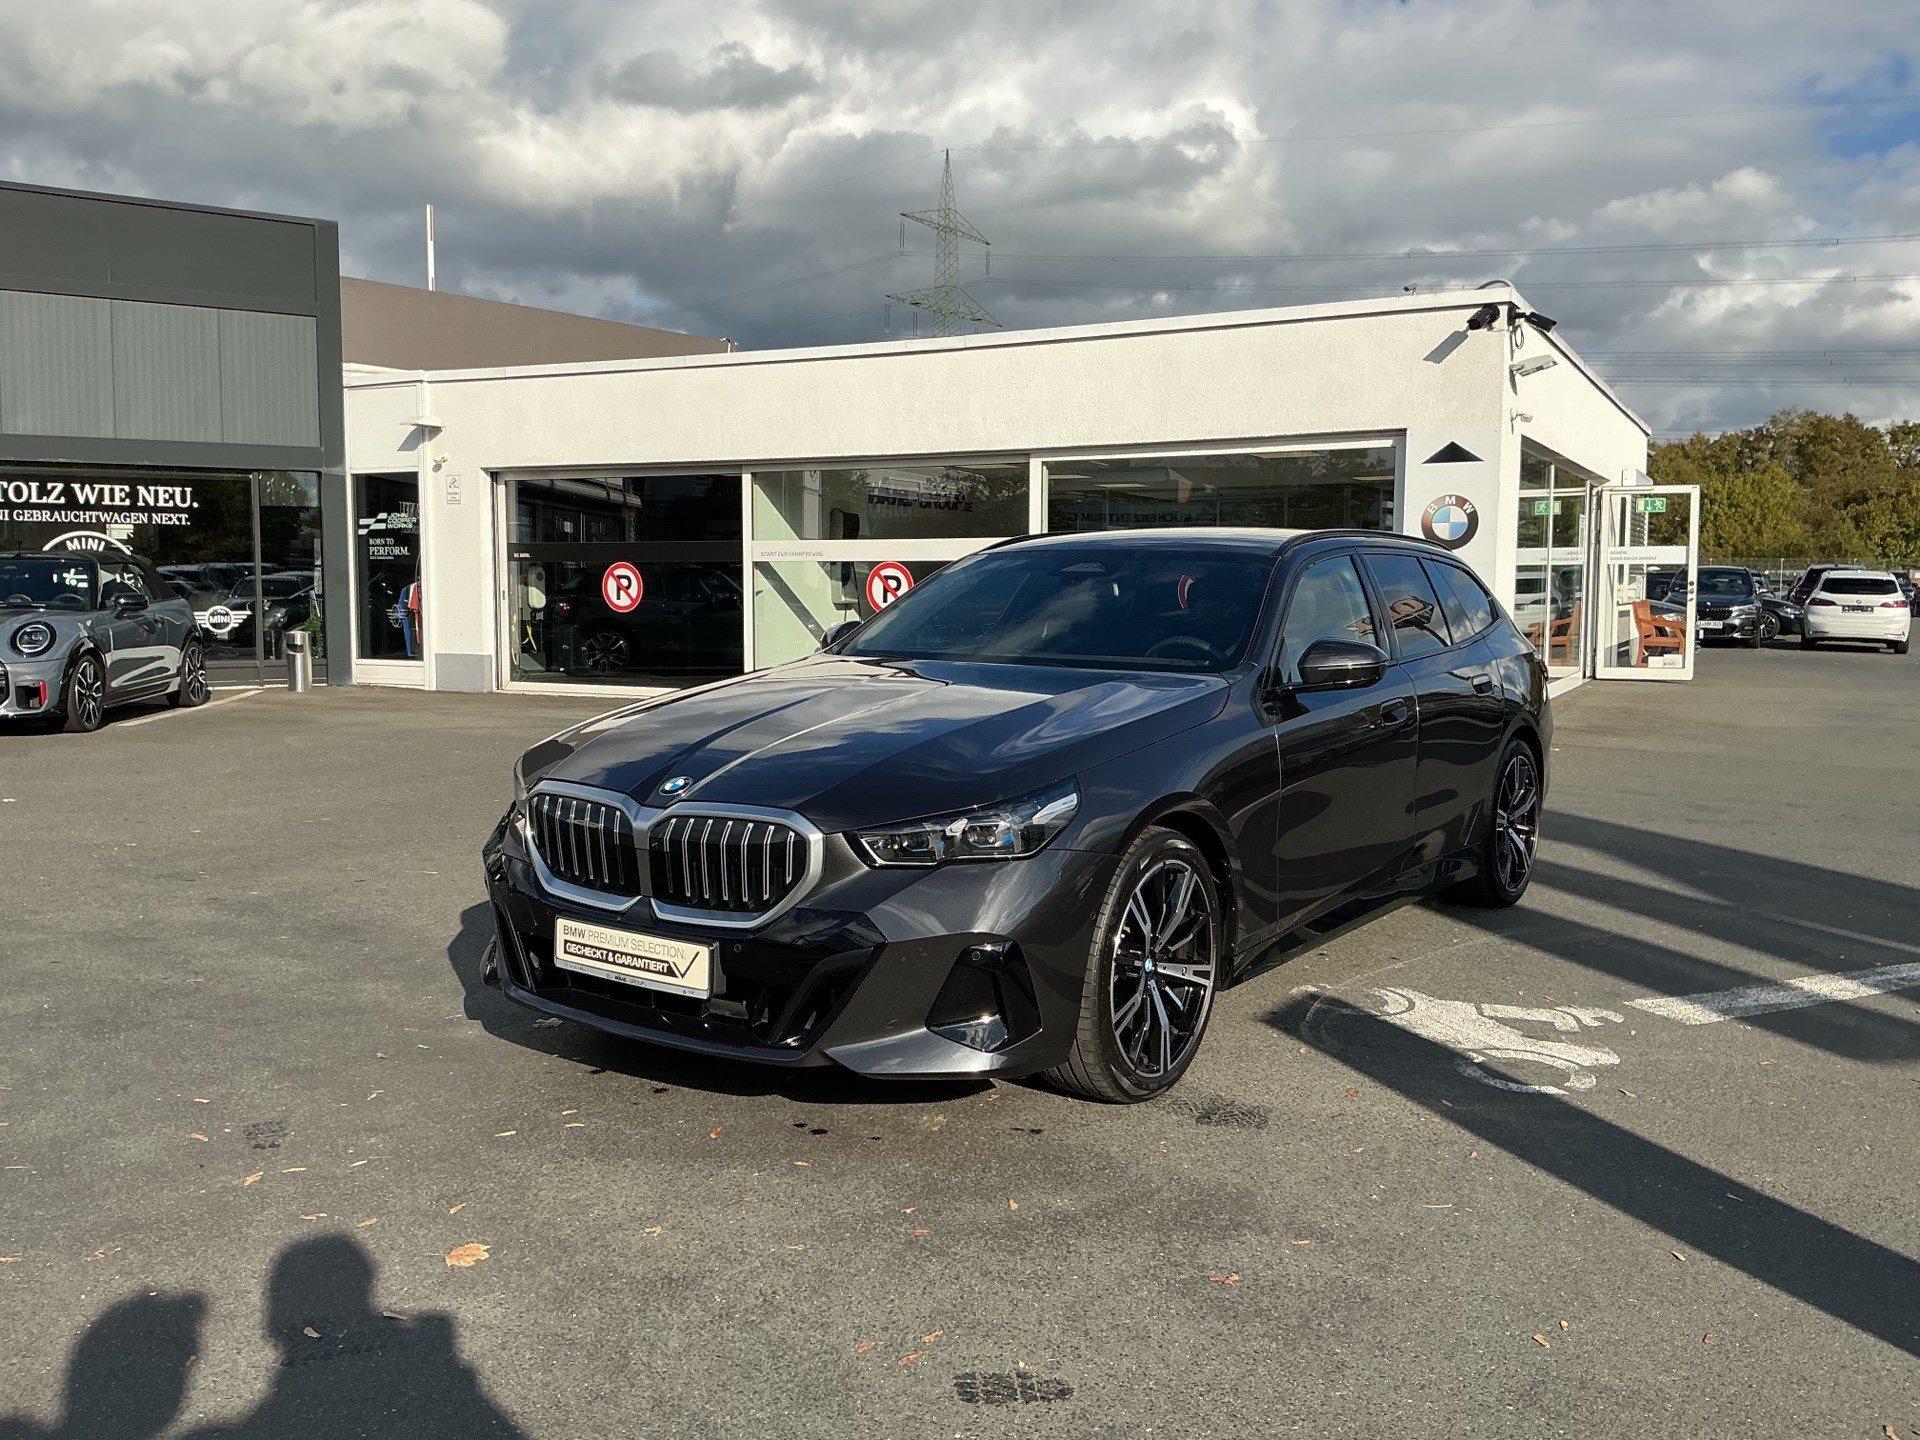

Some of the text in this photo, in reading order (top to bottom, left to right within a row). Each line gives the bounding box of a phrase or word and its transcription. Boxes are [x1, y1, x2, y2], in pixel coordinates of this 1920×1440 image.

[70, 483, 130, 505] WIE
[136, 485, 199, 508] NEU.
[1427, 495, 1475, 515] BMW
[12, 509, 148, 524] GEBRAUCHTWAGEN
[151, 513, 191, 526] NEXT.
[66, 536, 106, 552] MINI
[368, 538, 395, 546] BORN TO
[209, 614, 231, 624] MINI
[563, 925, 586, 939] BMW
[588, 930, 629, 949] PREMIUM
[566, 942, 669, 973] GECHECKT & GARANTIERT
